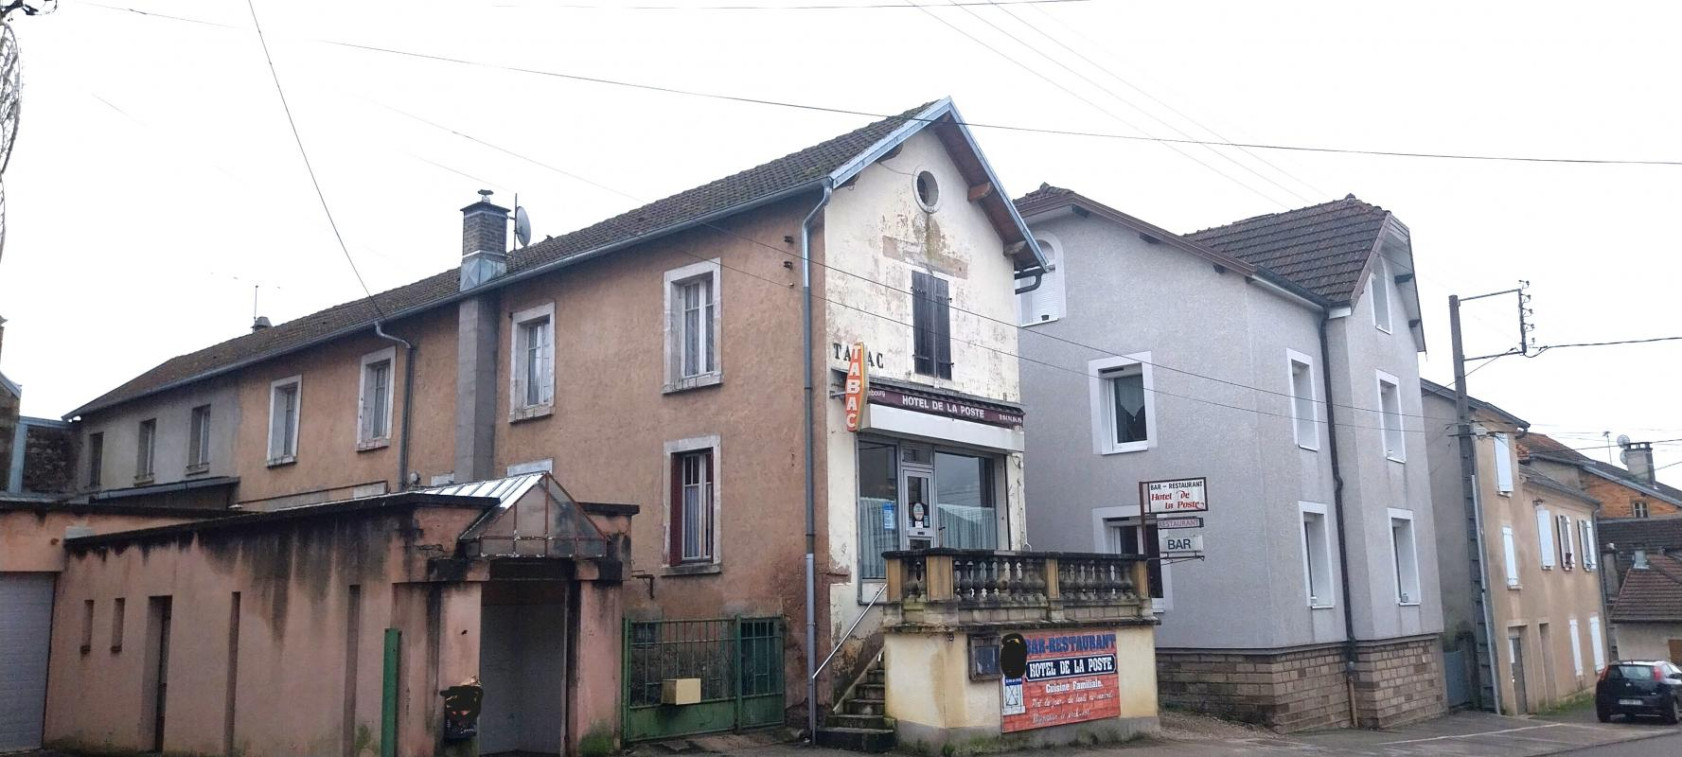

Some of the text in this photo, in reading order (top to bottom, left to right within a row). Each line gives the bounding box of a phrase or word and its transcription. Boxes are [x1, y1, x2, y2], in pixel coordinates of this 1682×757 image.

[833, 342, 884, 369] TAAC
[846, 345, 861, 428] TABAC
[902, 395, 985, 418] HOTEL DE LA POSTE
[1168, 481, 1203, 489] RESTAURANT
[1151, 493, 1172, 501] Hotel
[1177, 501, 1200, 509] Poste
[1167, 539, 1191, 550] BAR
[1029, 657, 1113, 678] HOTEL DE LA POSTE
[1045, 683, 1070, 693] Cuisine
